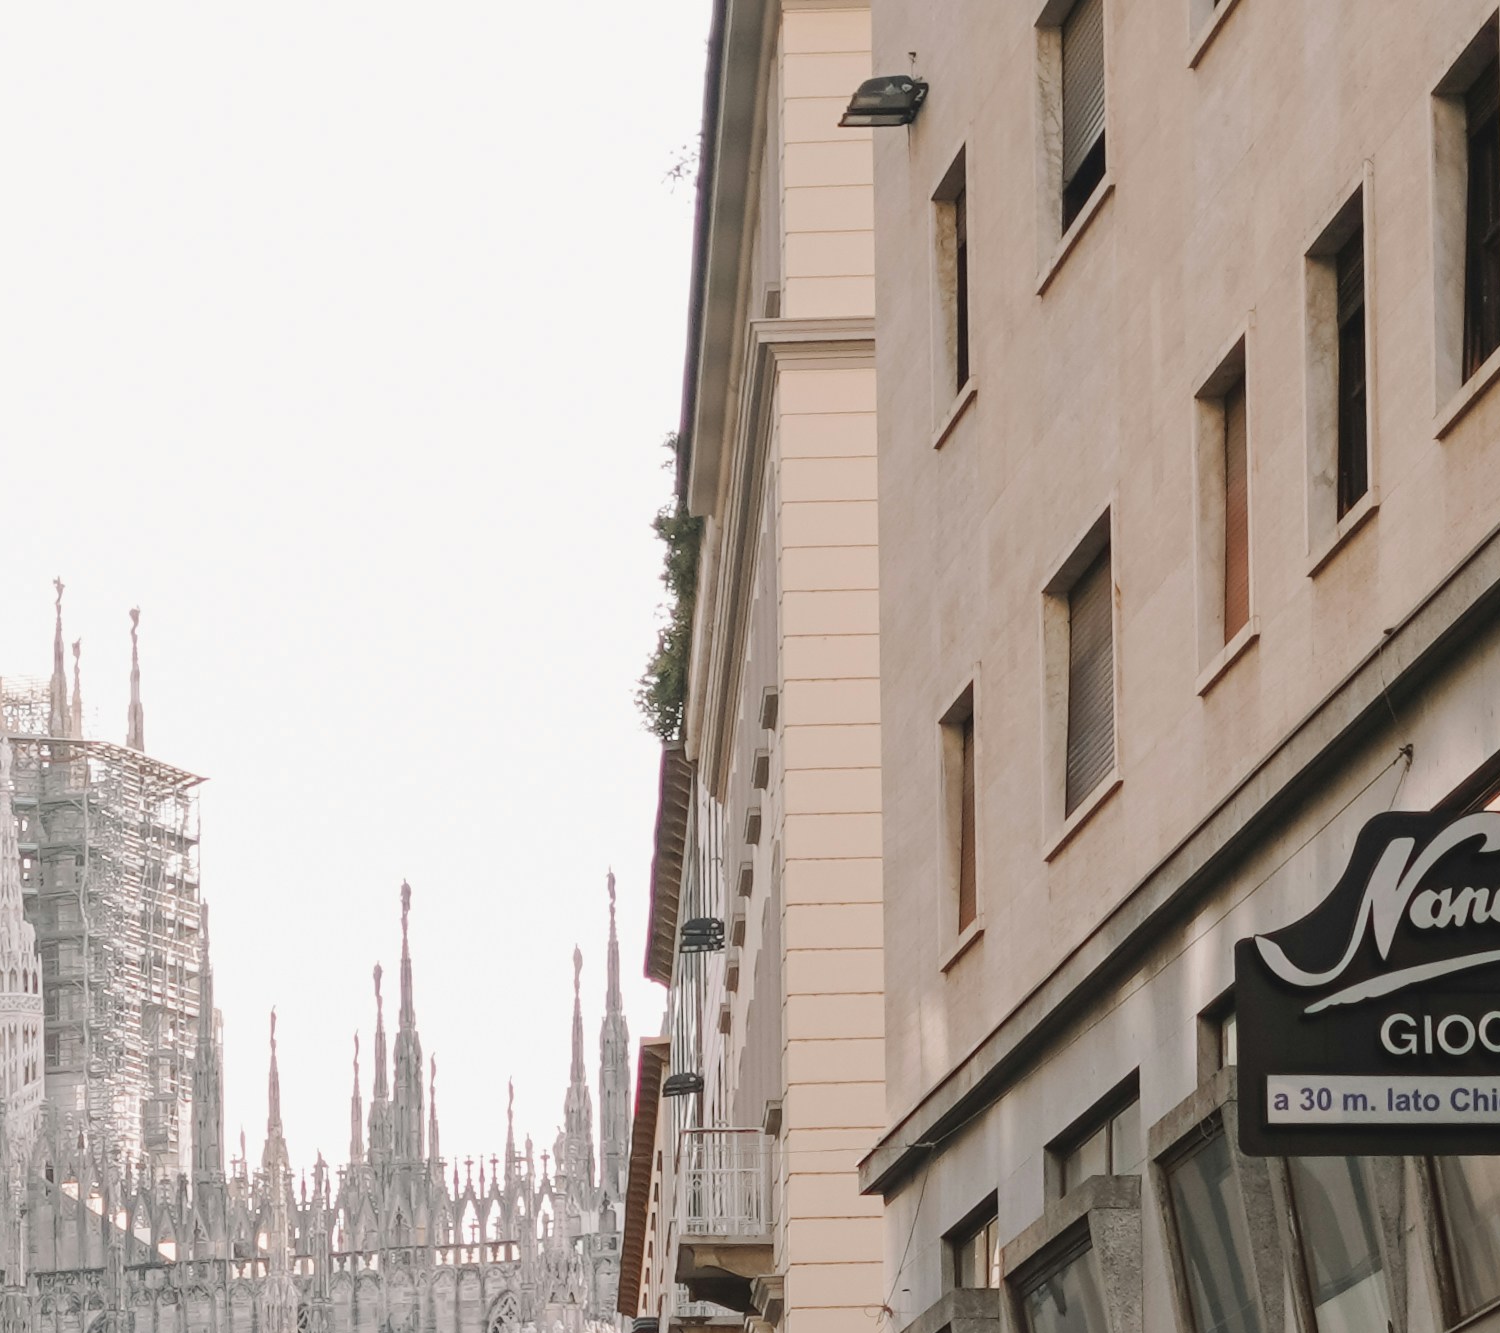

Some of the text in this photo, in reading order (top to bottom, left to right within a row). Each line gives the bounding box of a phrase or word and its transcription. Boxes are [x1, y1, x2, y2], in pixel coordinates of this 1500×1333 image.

[1273, 1092, 1290, 1111] a
[1300, 1088, 1332, 1111] 30
[1342, 1092, 1377, 1111] m.
[1386, 1088, 1440, 1112] lato
